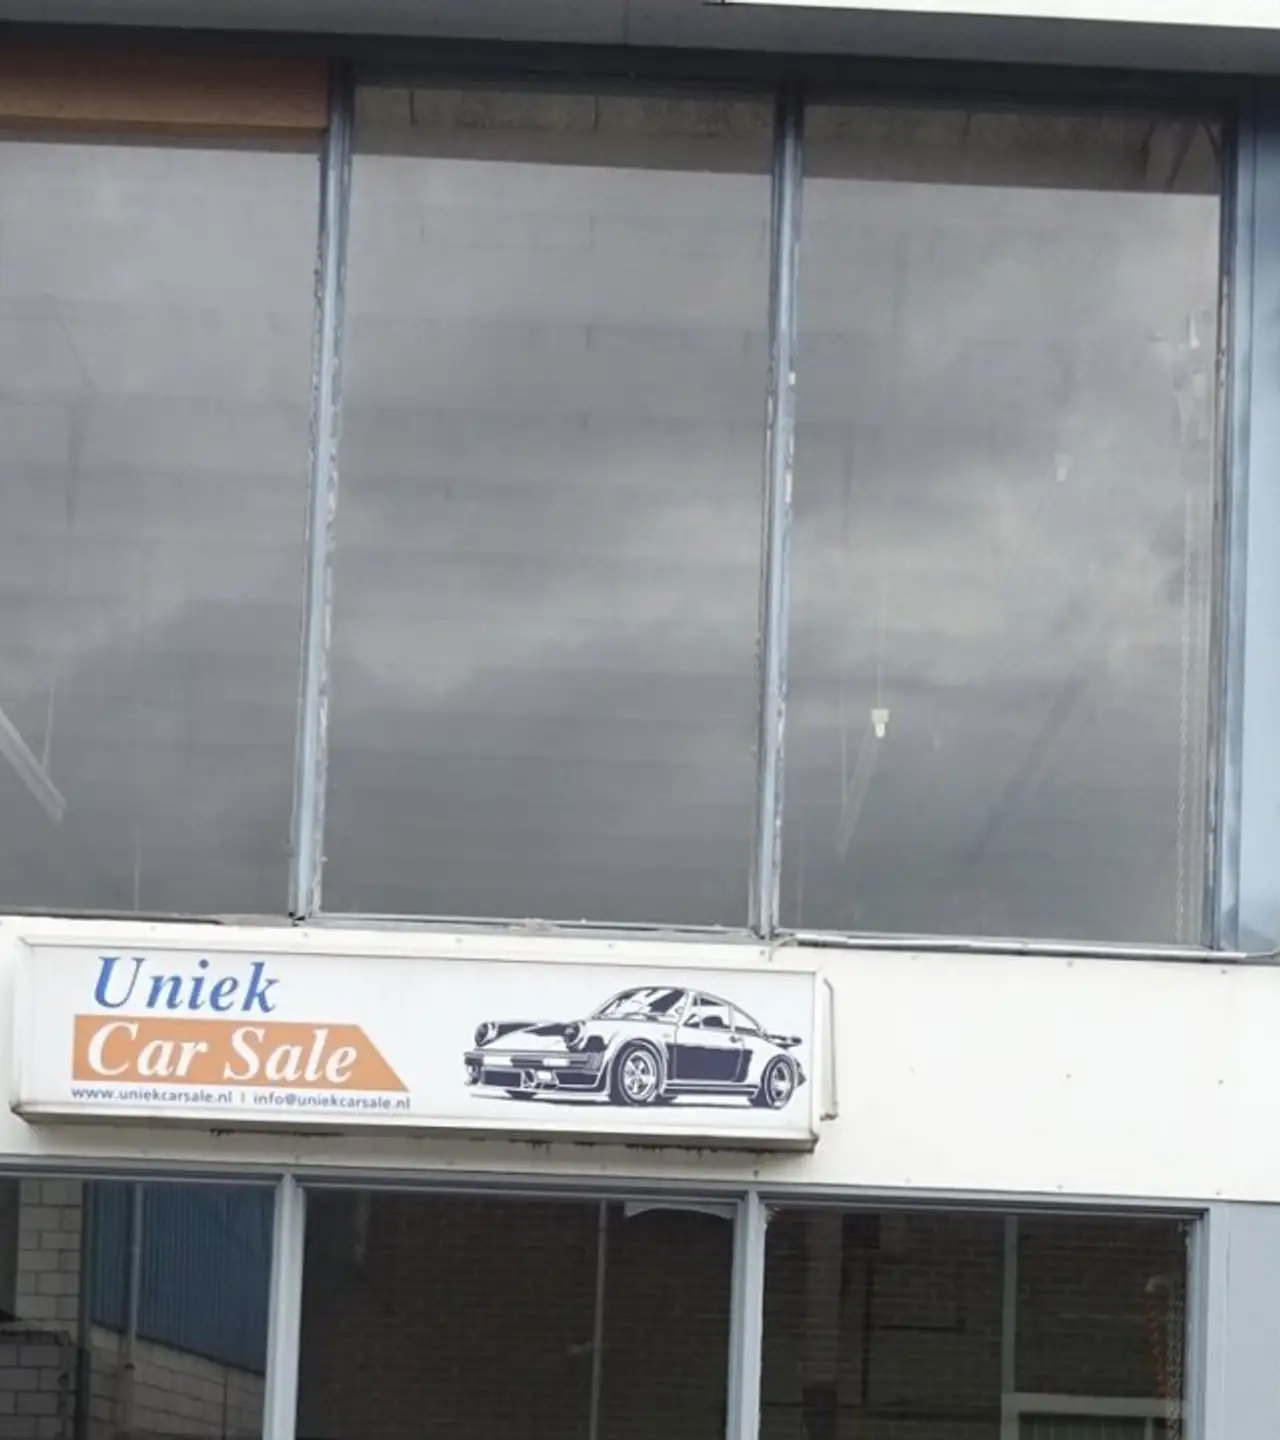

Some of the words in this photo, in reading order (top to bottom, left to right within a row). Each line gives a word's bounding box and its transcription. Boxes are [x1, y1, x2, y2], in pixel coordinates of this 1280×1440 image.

[94, 956, 280, 1014] Uniek
[87, 1020, 209, 1077] Car
[222, 1025, 358, 1084] Sale
[71, 1086, 233, 1104] www.uniekcarsale.nl
[253, 1091, 411, 1110] info@uniekcarsale.nl
